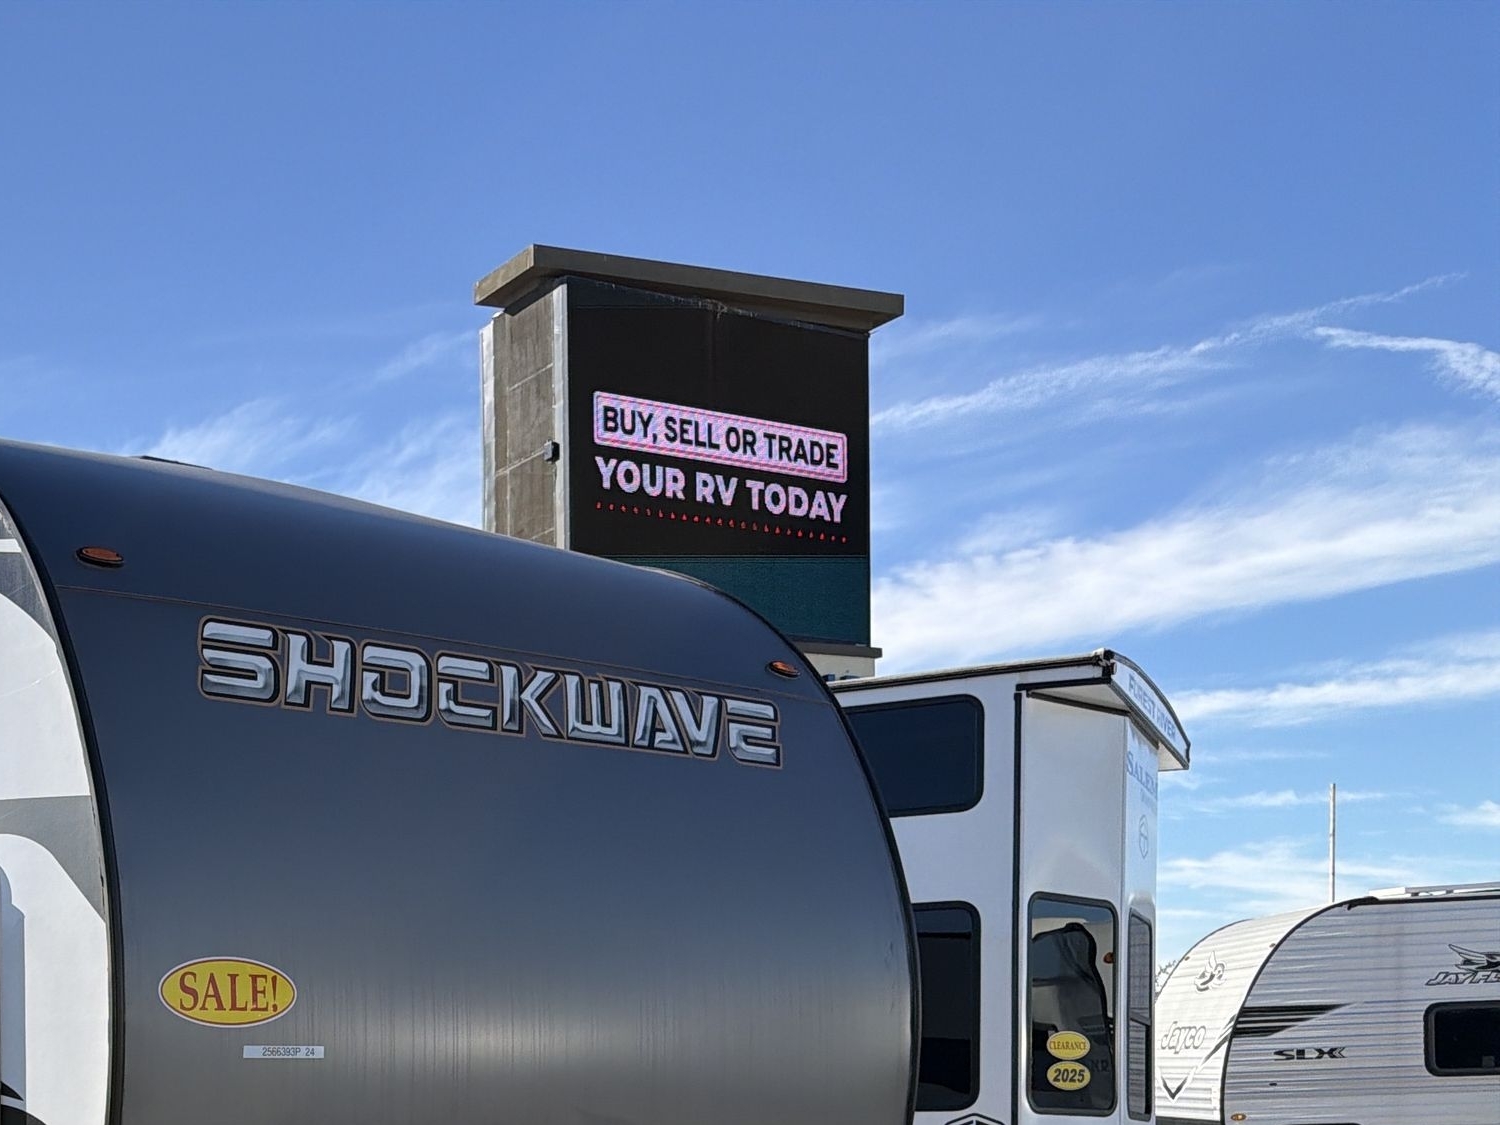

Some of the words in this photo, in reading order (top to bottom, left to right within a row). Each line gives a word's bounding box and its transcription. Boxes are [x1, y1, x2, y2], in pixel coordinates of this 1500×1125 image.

[603, 405, 658, 444] BUY,
[664, 416, 720, 451] SELL
[725, 426, 757, 456] OR
[763, 432, 839, 470] TRADE
[595, 456, 686, 500] YOUR
[695, 471, 738, 507] RV
[745, 479, 848, 523] TODAY
[198, 615, 784, 768] SHOCKWAVE
[1425, 971, 1471, 986] JAY
[1468, 971, 1500, 984] FL
[179, 971, 278, 1012] SALE!
[1049, 1041, 1087, 1050] CLEARANCE
[1160, 1021, 1207, 1054] Jayco
[305, 1047, 315, 1056] 24
[1273, 1047, 1346, 1061] SLX
[1053, 1068, 1085, 1083] 2025
